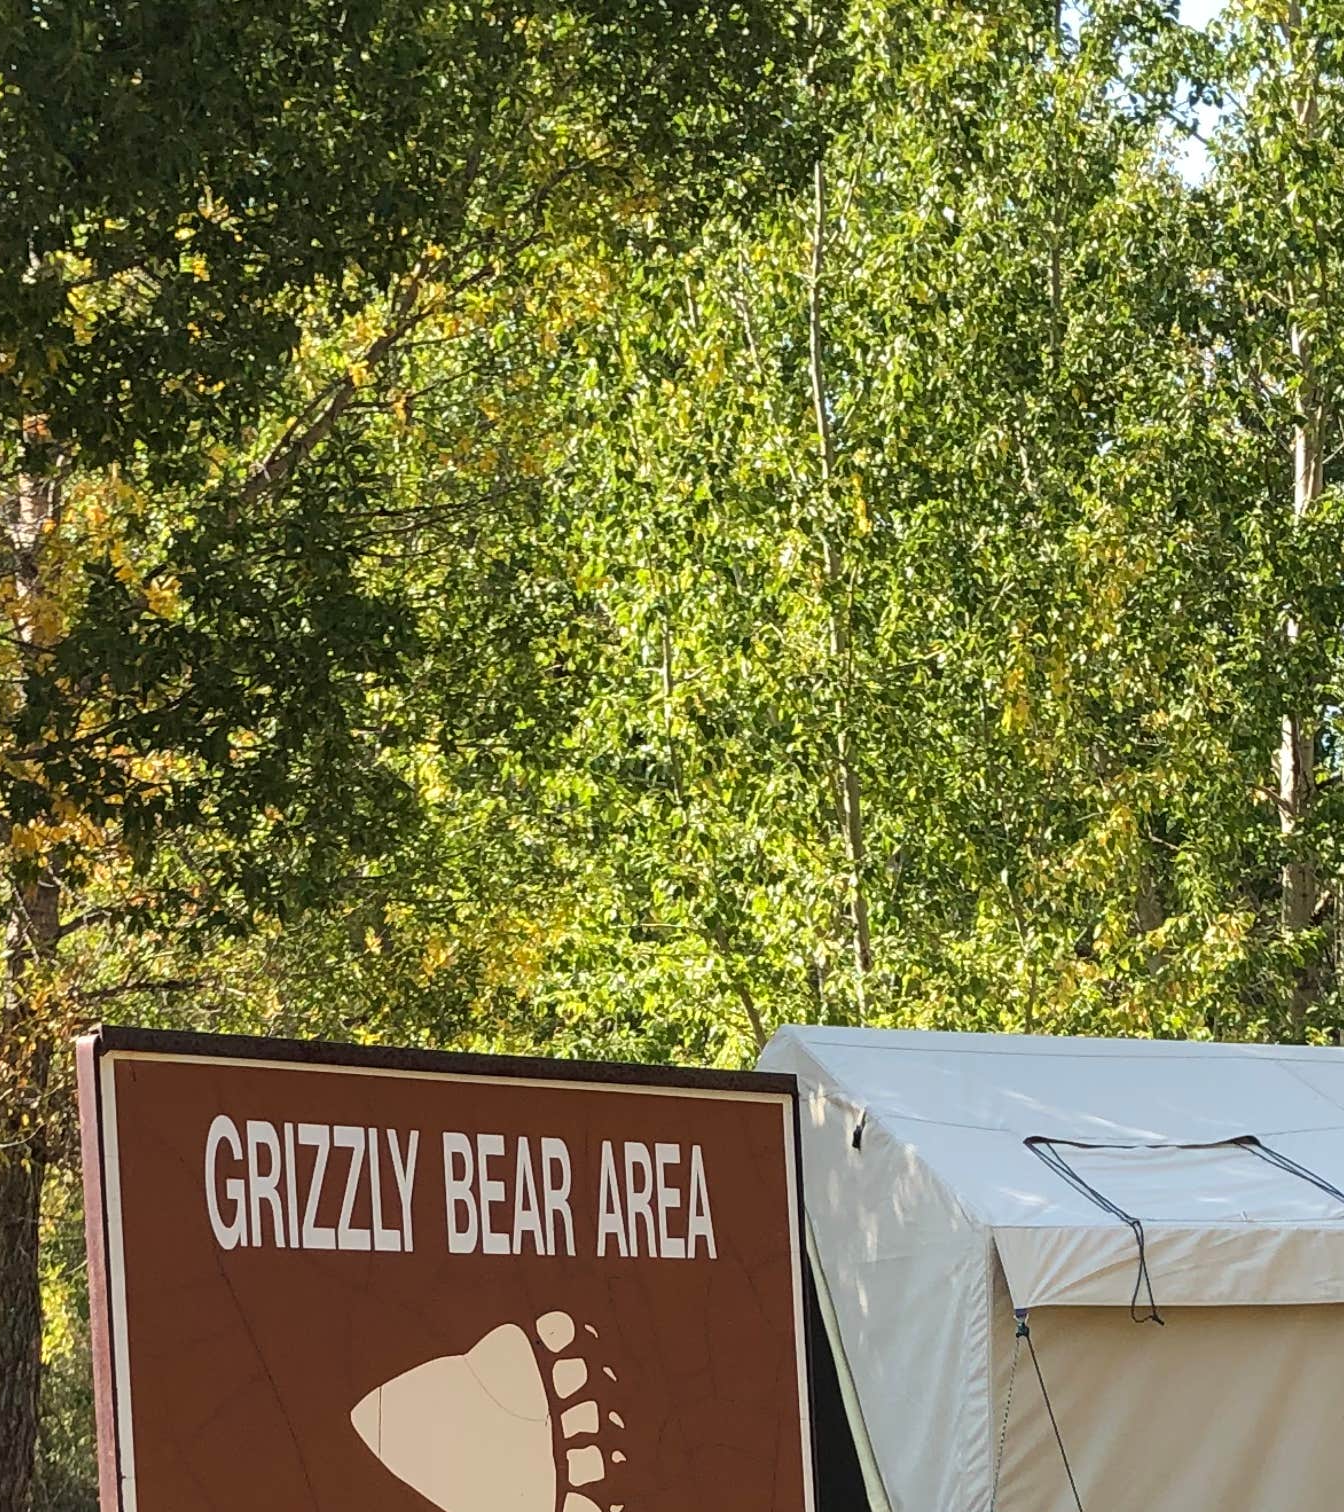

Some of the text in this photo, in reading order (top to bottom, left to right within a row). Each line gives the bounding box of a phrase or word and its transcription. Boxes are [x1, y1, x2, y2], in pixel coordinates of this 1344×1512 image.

[205, 1114, 717, 1259] GRIZZLY BEAR AREA
